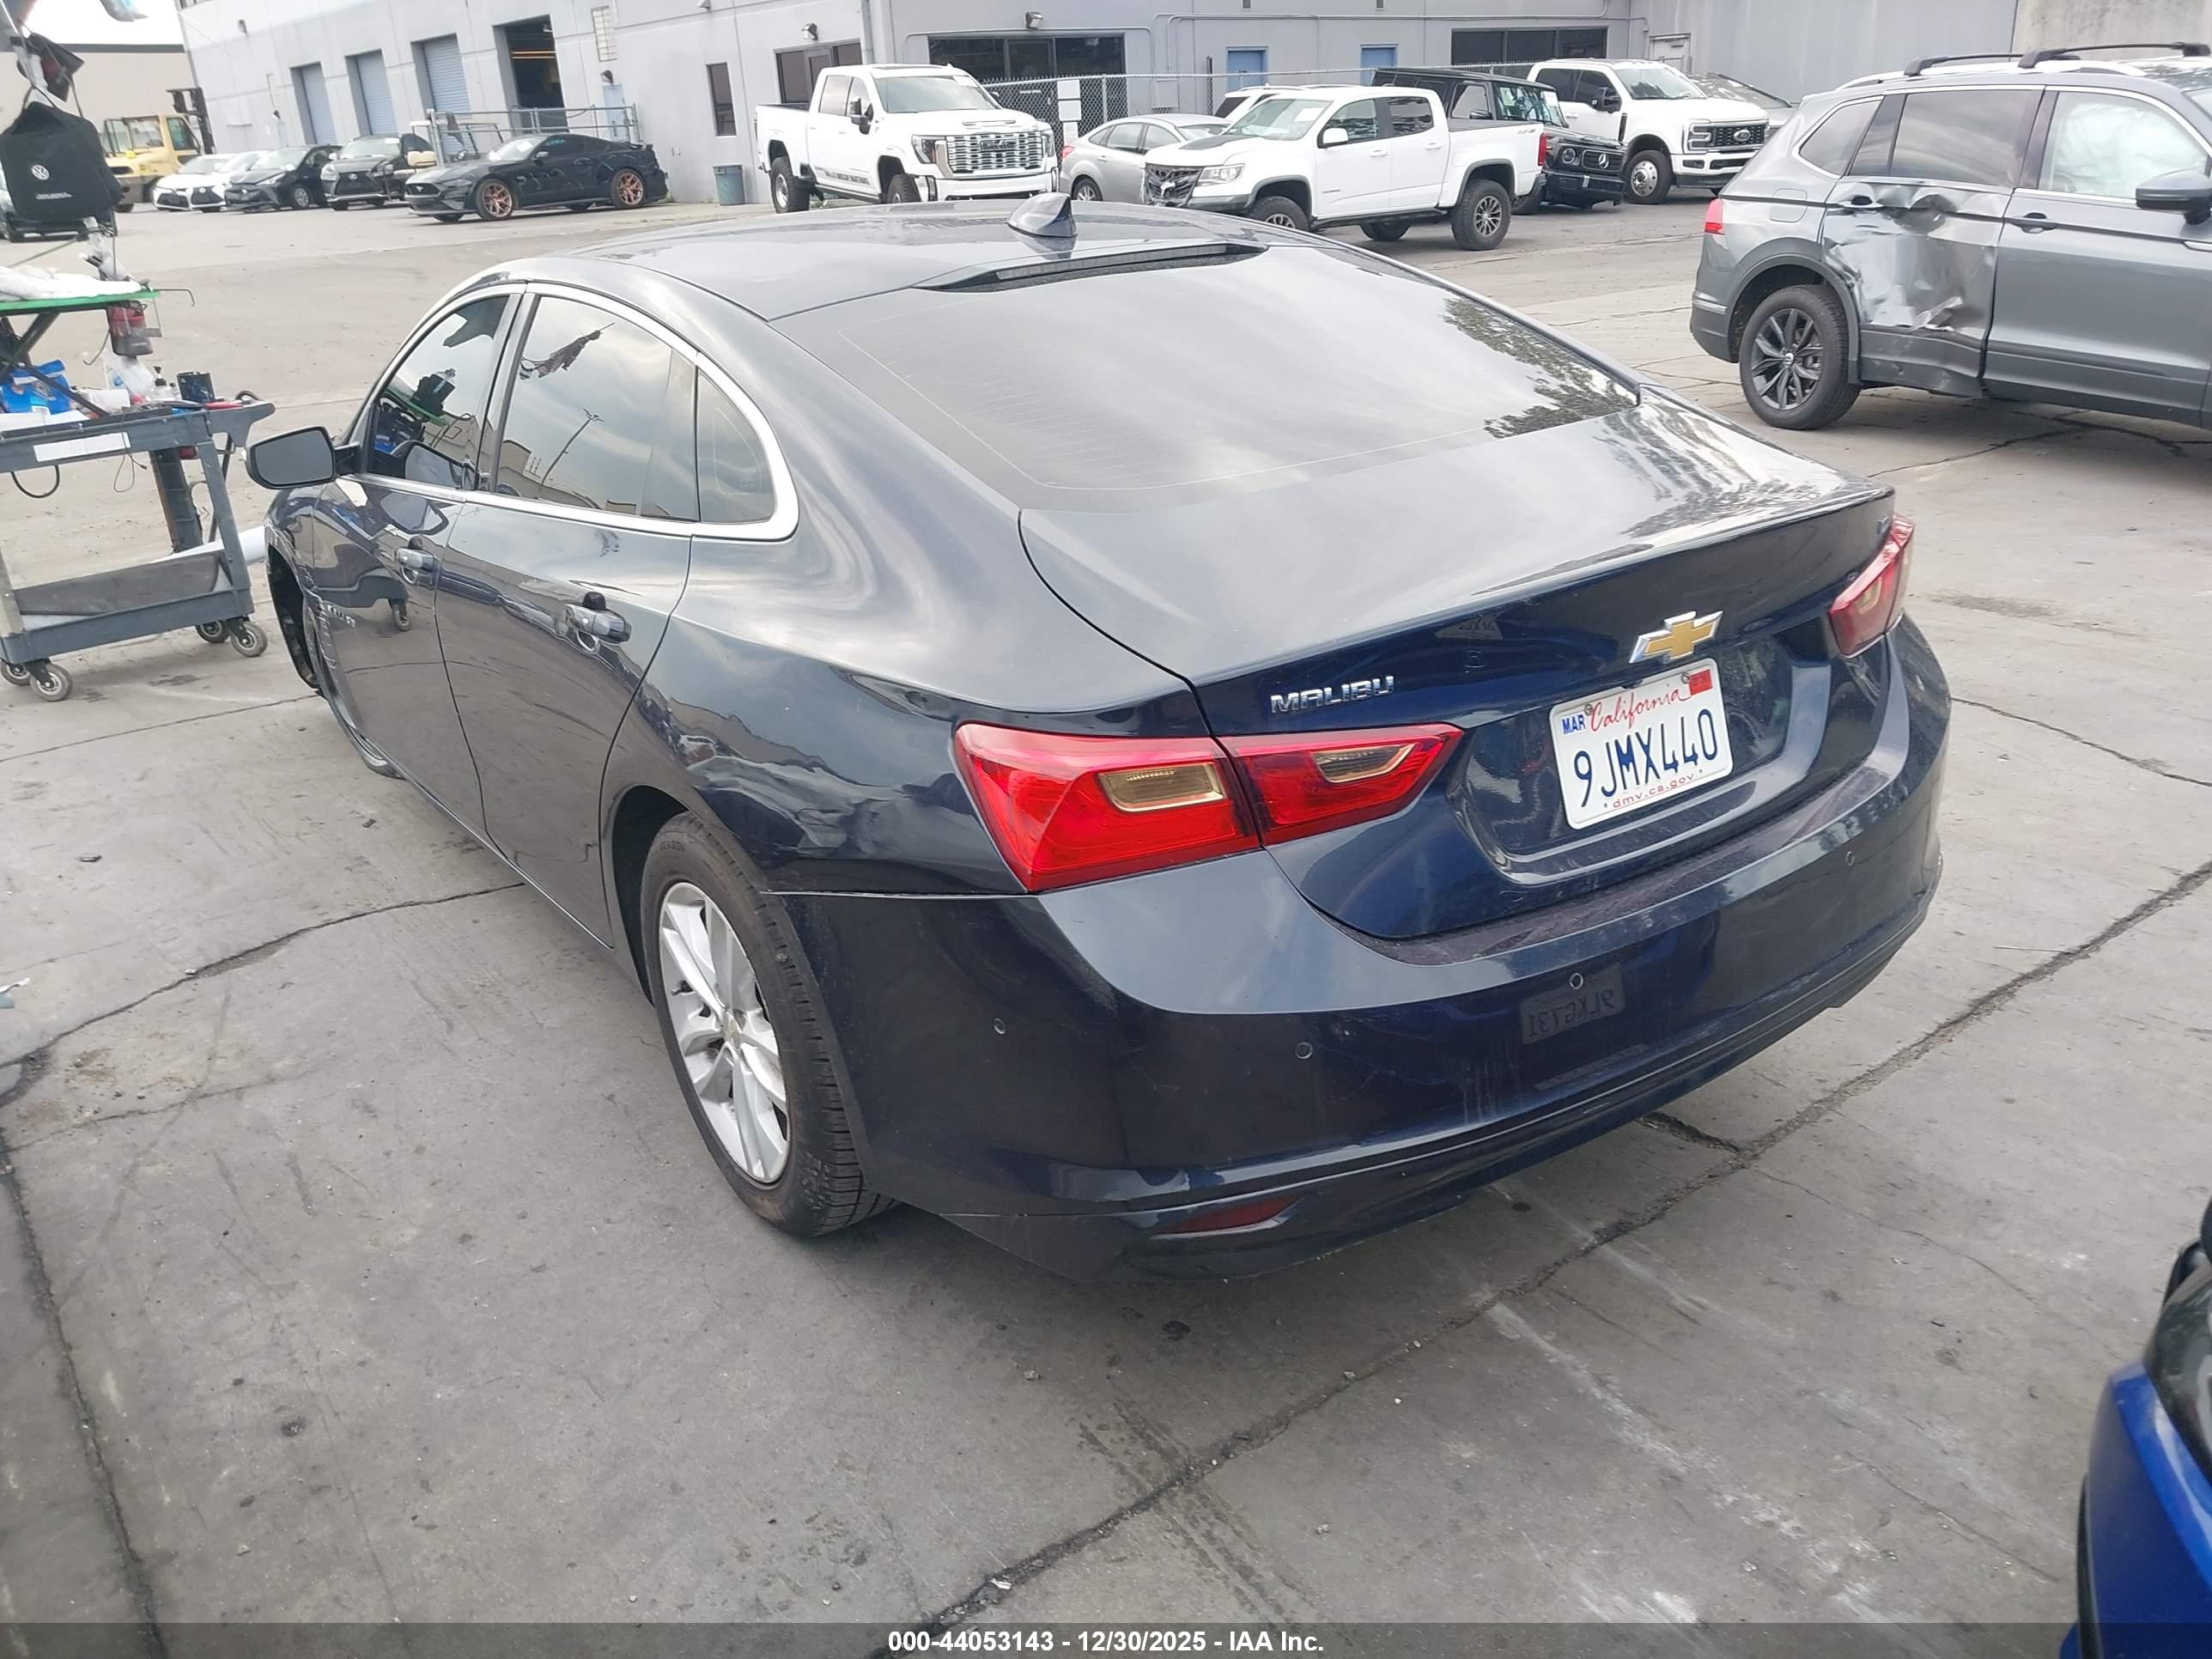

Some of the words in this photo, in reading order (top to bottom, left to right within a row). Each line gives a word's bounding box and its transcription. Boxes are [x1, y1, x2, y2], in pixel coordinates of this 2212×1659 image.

[1271, 675, 1395, 714] MALIBU
[1590, 688, 1692, 732] California
[1561, 714, 1587, 735] MAR
[1574, 708, 1718, 808] 9JMX440
[1613, 773, 1695, 809] dmv.ca.gov
